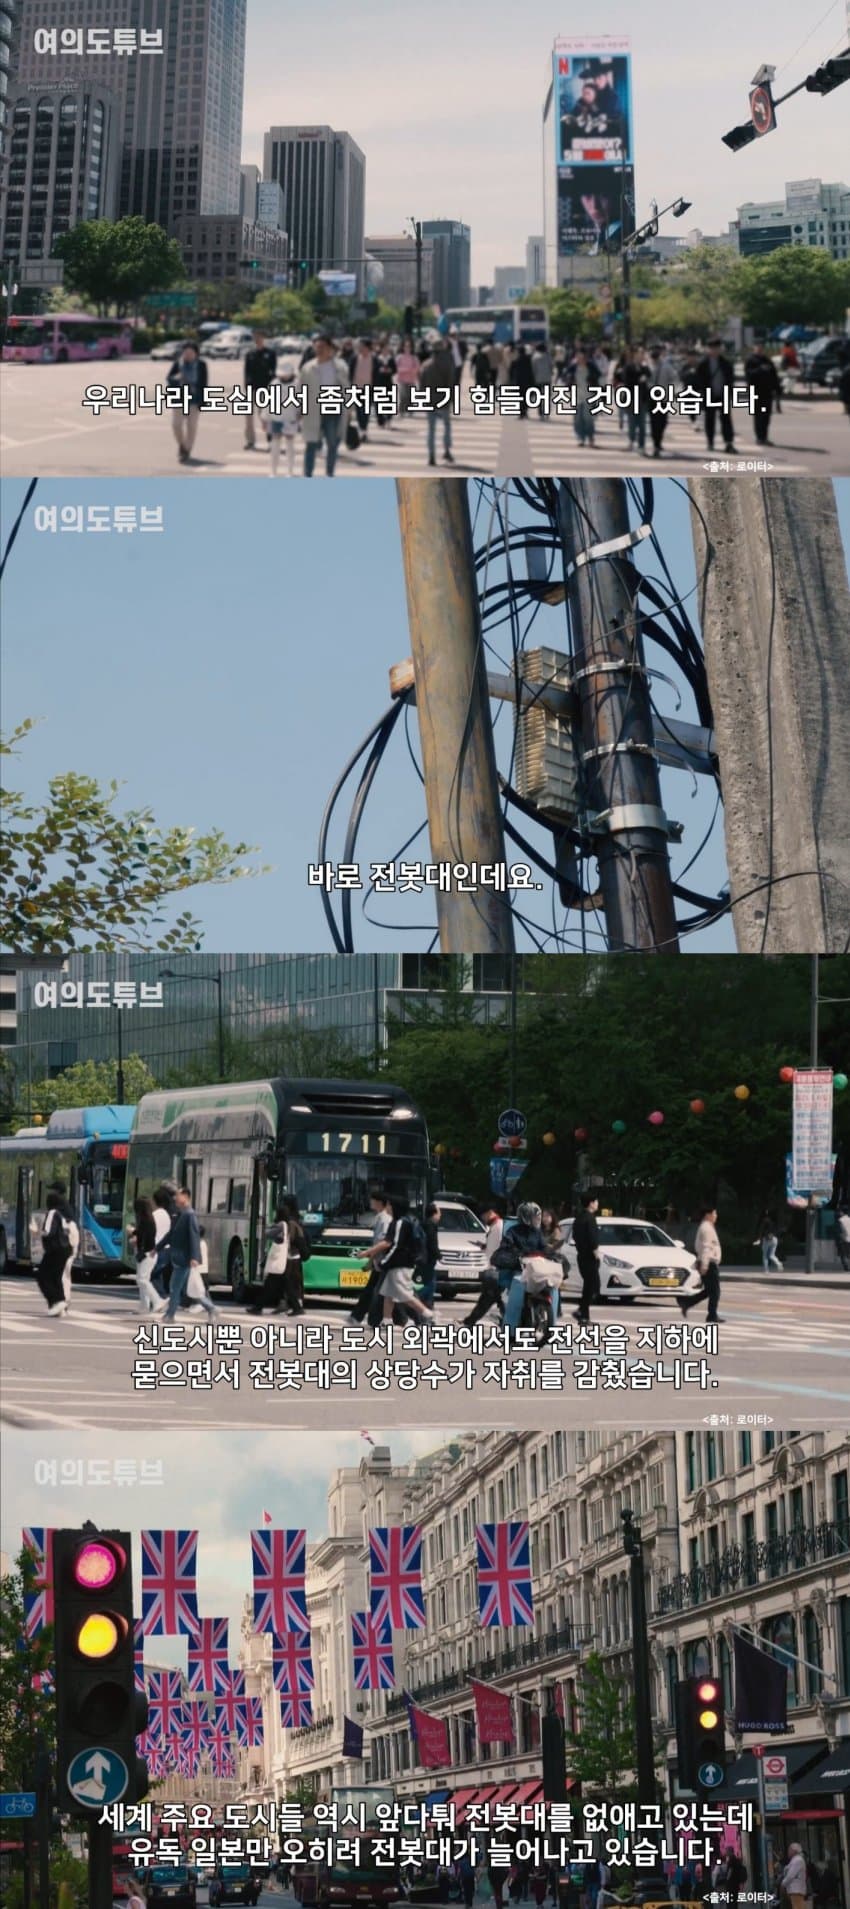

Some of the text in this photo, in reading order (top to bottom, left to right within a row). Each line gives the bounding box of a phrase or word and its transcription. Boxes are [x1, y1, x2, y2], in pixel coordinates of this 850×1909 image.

[321, 1132, 386, 1155] 1711
[738, 1721, 785, 1730] HUGO BOSS
